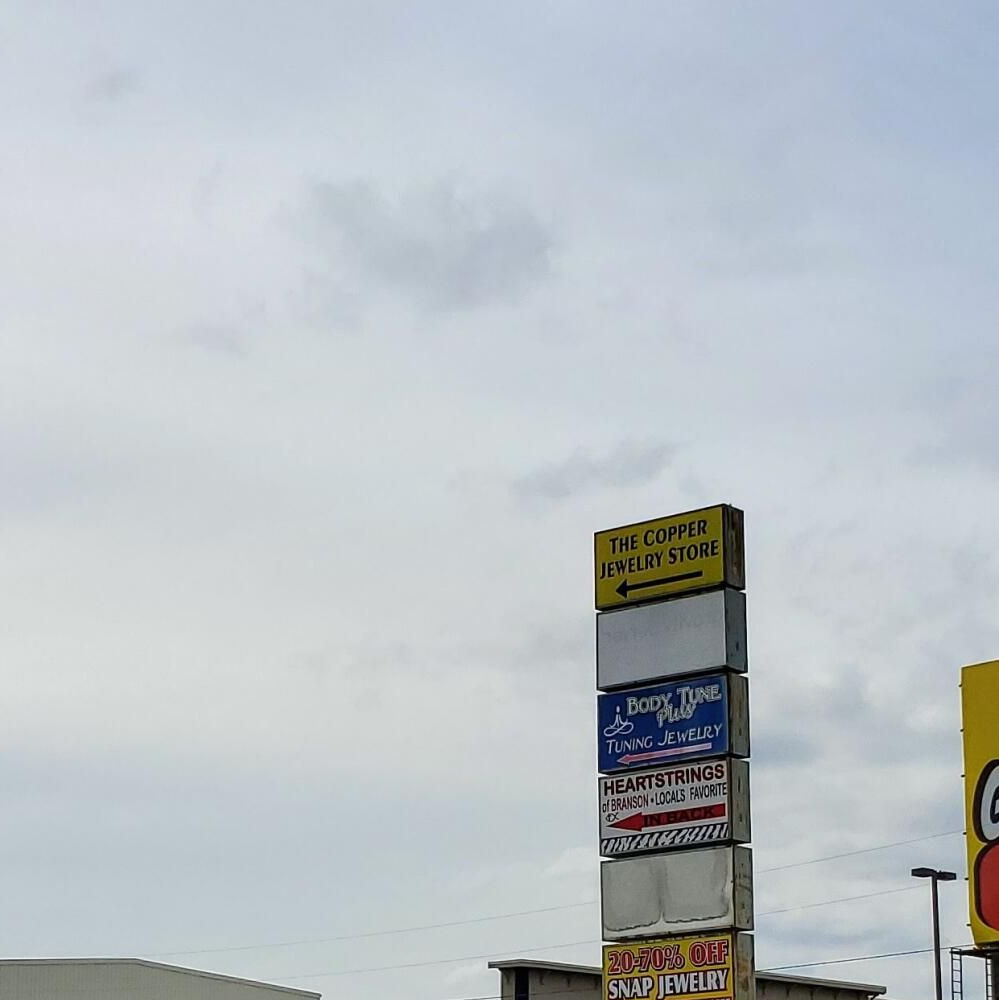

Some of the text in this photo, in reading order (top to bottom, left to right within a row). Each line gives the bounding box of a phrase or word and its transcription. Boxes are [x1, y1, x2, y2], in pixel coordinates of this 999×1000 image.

[609, 519, 708, 555] THE COPPER
[600, 539, 719, 580] JEWELRY STORE
[626, 684, 722, 717] BODY TUNE
[605, 723, 723, 755] TUNING JEWELRY
[603, 763, 725, 797] HEARTSTRINGS
[602, 799, 611, 814] of
[611, 793, 649, 812] BRANSON
[689, 782, 728, 801] FAVORITE
[607, 939, 729, 976] 20-70% OFF
[608, 968, 730, 1000] SNAP JEWELRY
